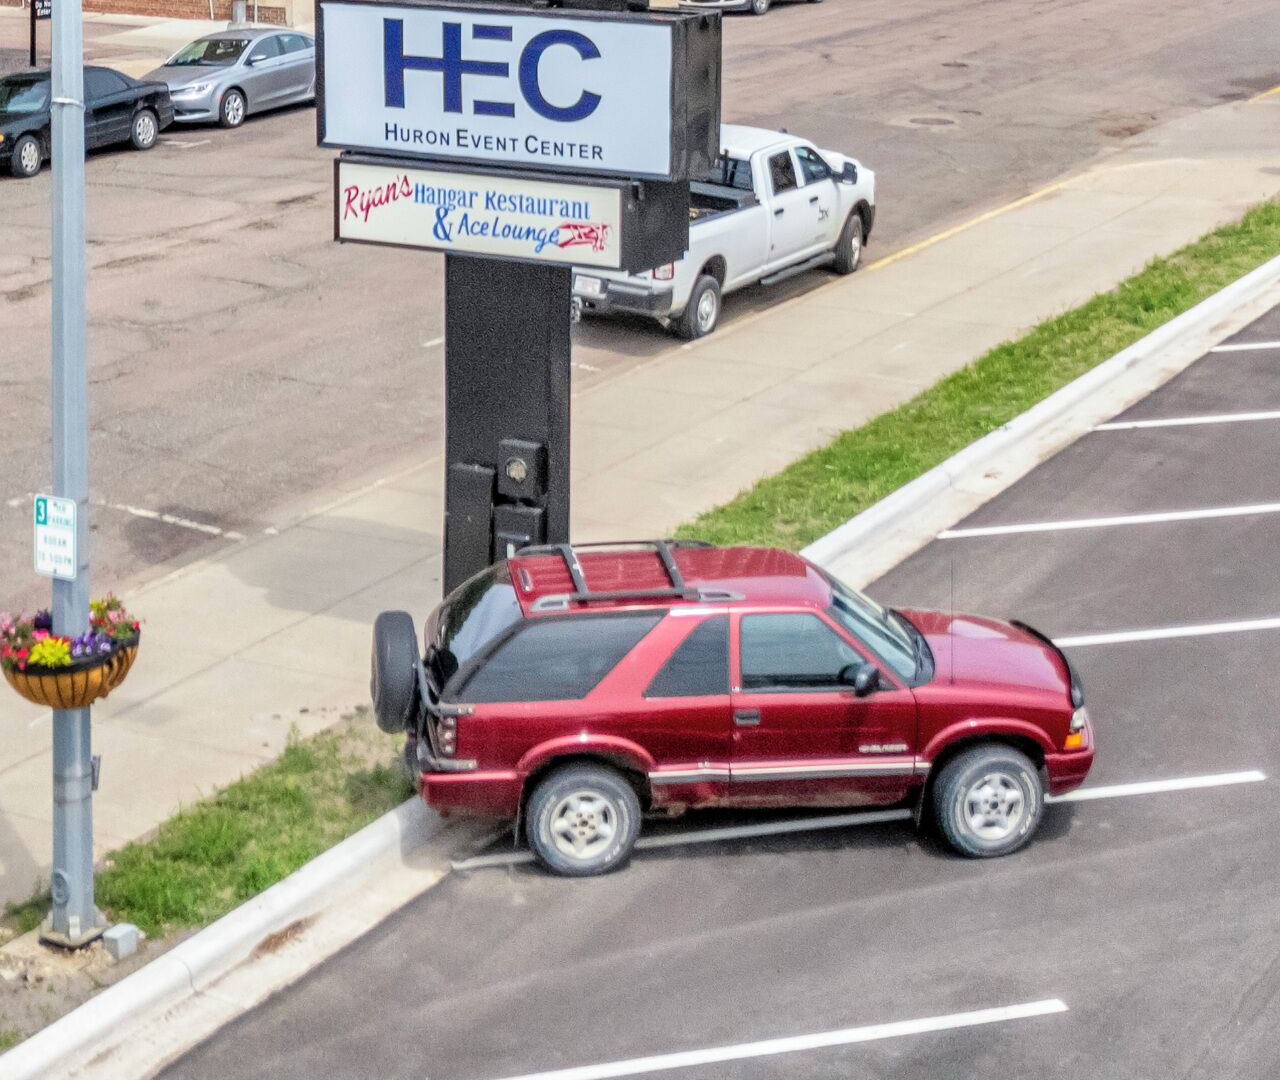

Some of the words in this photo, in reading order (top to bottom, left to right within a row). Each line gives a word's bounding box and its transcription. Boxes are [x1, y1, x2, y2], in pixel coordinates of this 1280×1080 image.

[383, 17, 602, 122] HEC
[384, 122, 450, 147] HURON
[455, 129, 519, 154] EVENT
[524, 135, 604, 161] CENTER
[344, 175, 413, 223] Ryan's
[414, 182, 479, 211] Hangar
[433, 206, 453, 242] &
[457, 212, 489, 237] Ace
[491, 216, 560, 254] Lounge
[37, 500, 46, 523] 3
